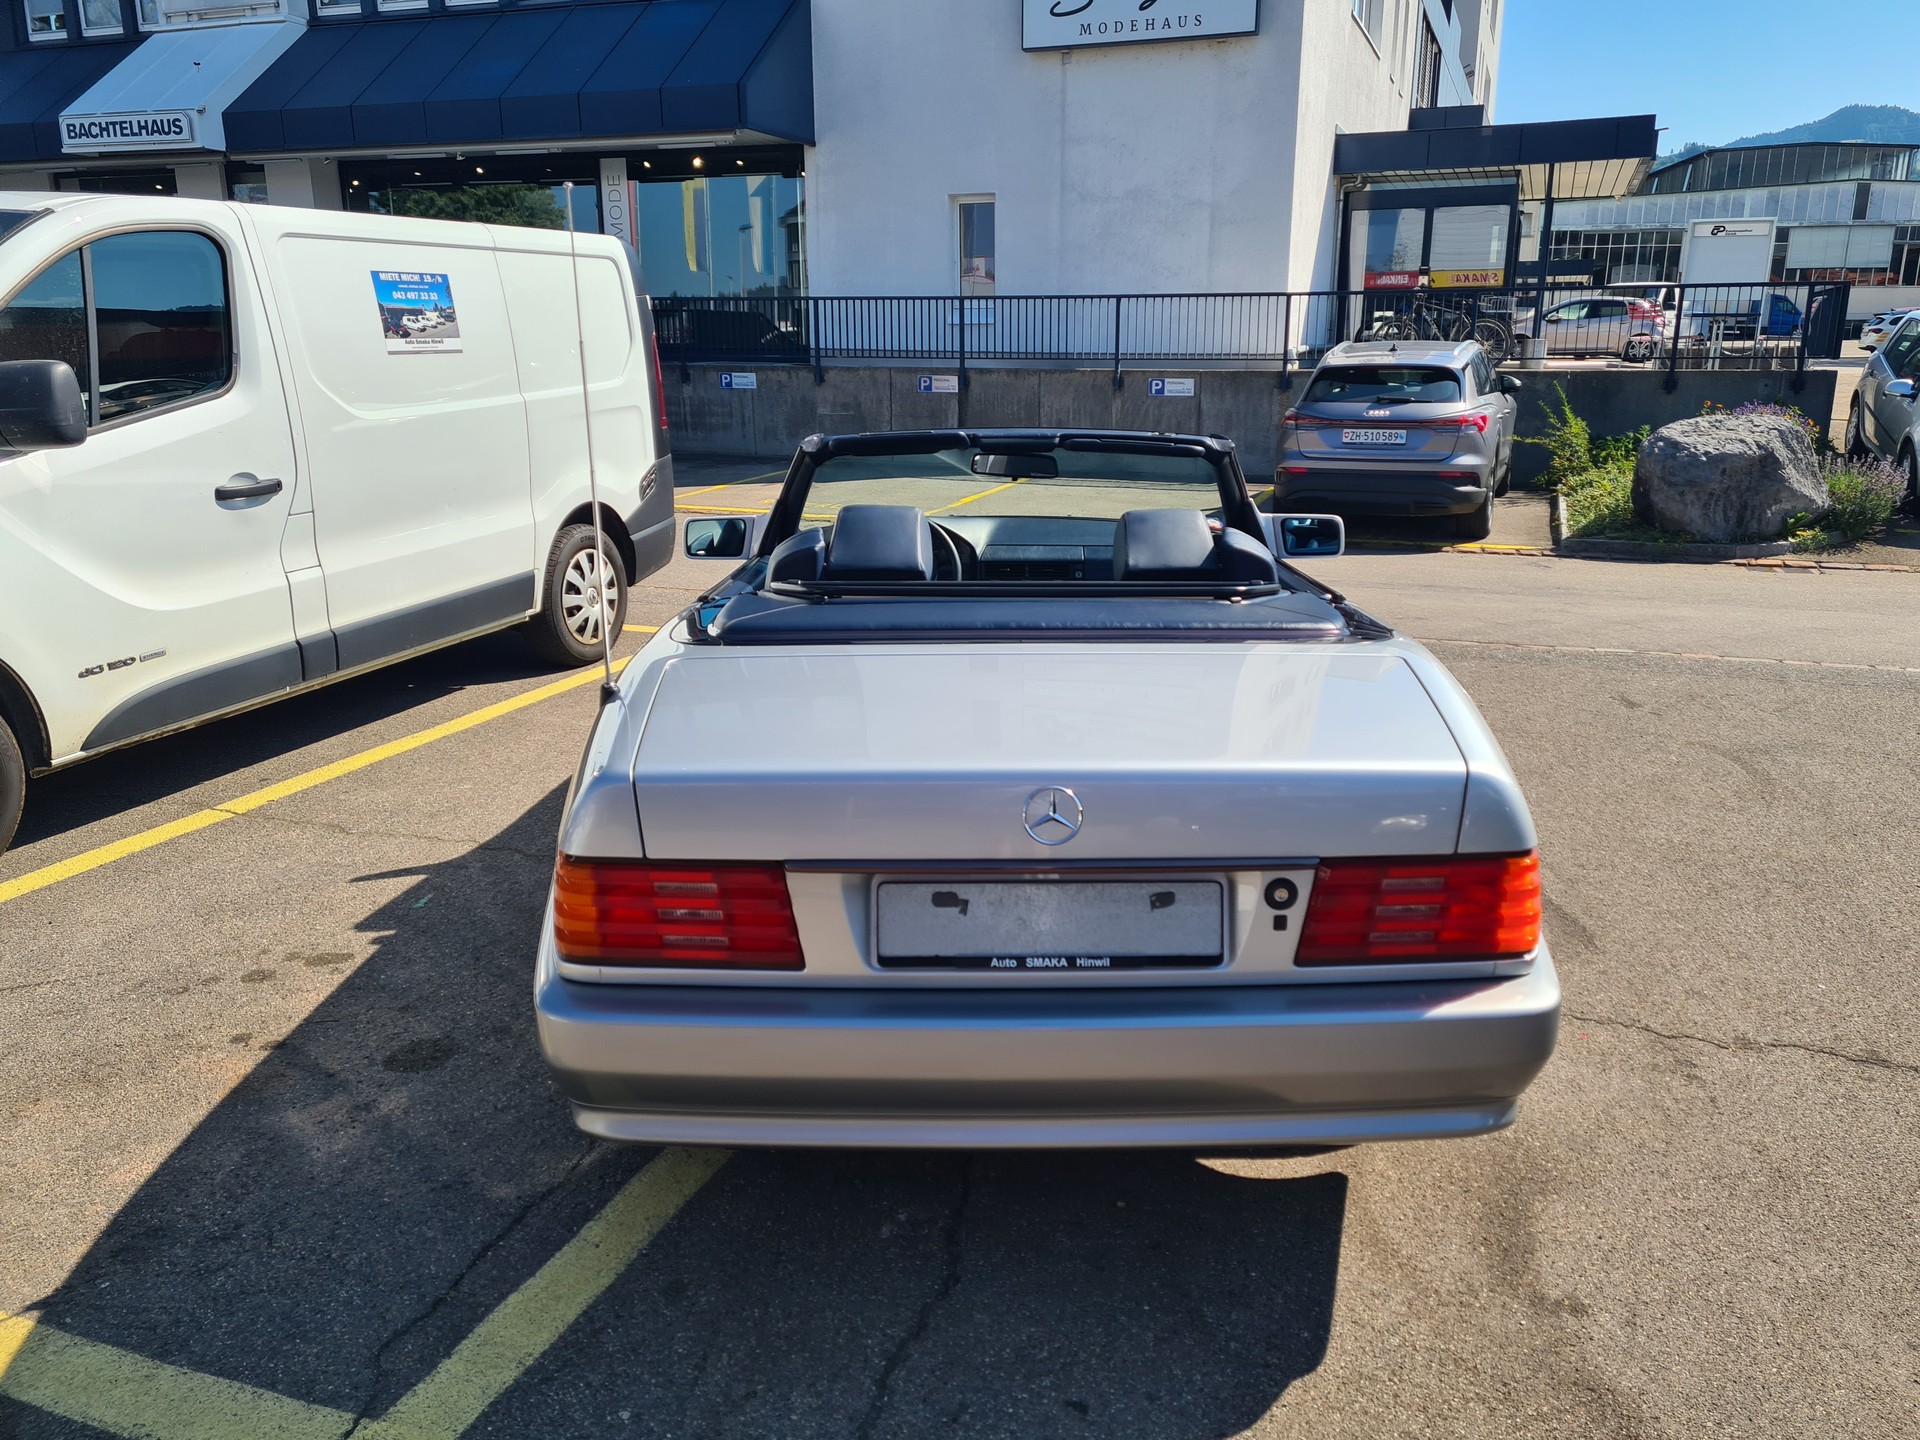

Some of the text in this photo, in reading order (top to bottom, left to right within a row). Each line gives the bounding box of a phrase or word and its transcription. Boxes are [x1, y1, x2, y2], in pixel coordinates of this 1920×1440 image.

[1079, 14, 1203, 36] MODEHAUS
[65, 117, 184, 140] BACHTELHAUS
[606, 174, 624, 239] MODE
[379, 272, 401, 281] MIETE
[400, 273, 421, 282] MICH!
[392, 291, 438, 300] 043 497 33 33
[721, 374, 731, 387] P
[921, 377, 930, 391] P
[1151, 380, 1163, 394] P
[107, 656, 136, 671] 120
[990, 957, 1110, 968] Auto SMAKA Hinwil
